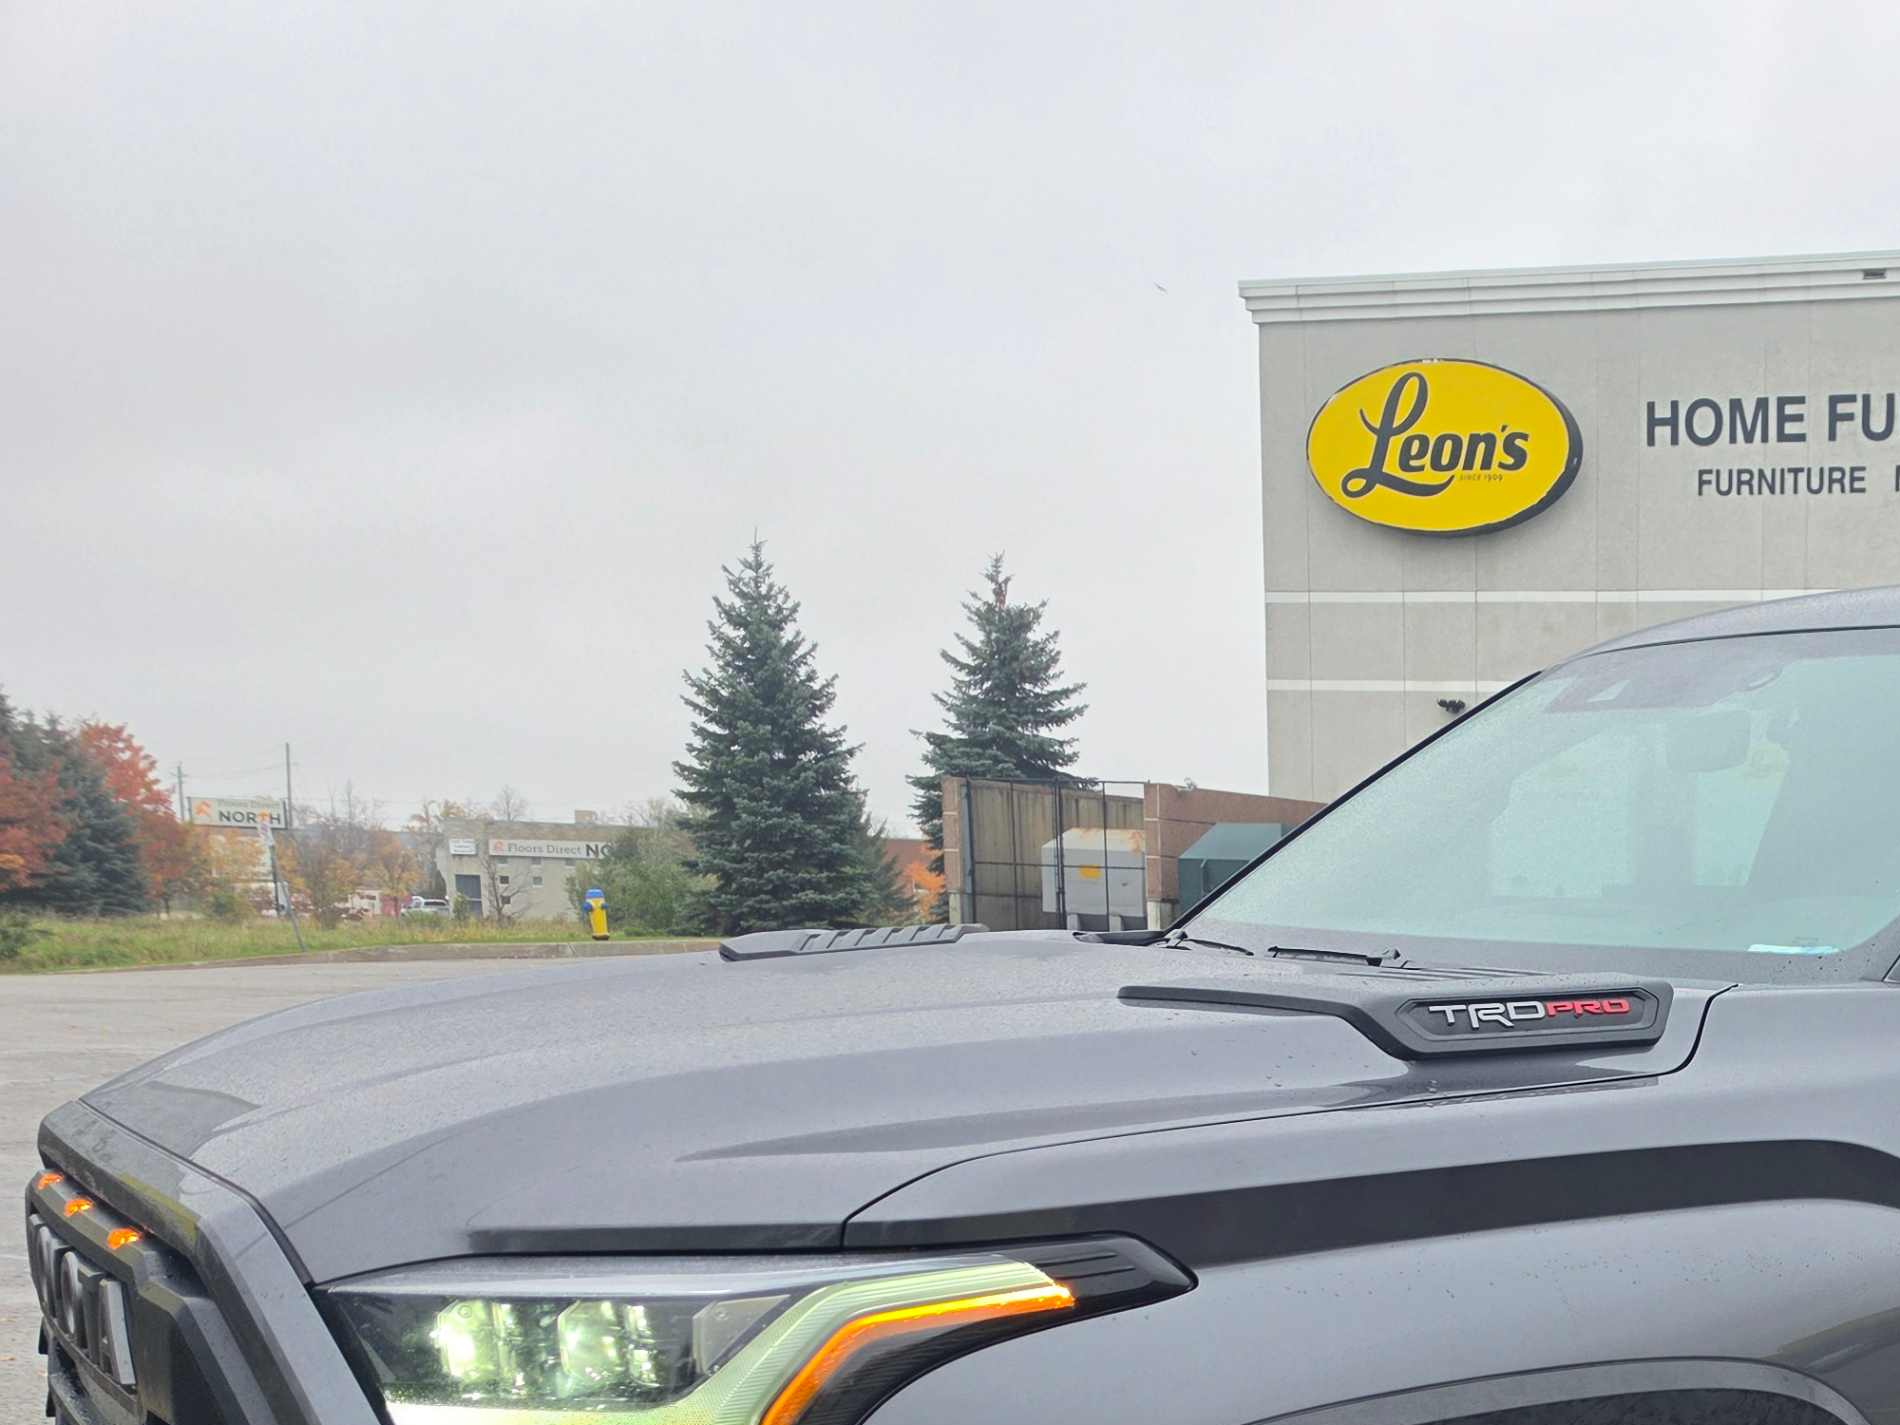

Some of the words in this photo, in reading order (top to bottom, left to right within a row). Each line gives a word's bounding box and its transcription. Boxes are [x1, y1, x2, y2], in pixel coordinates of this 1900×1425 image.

[1341, 371, 1529, 498] Leon's
[1646, 395, 1807, 447] HOME
[1698, 466, 1867, 496] FURNITURE
[507, 842, 543, 853] Floors
[546, 844, 580, 855] Direct
